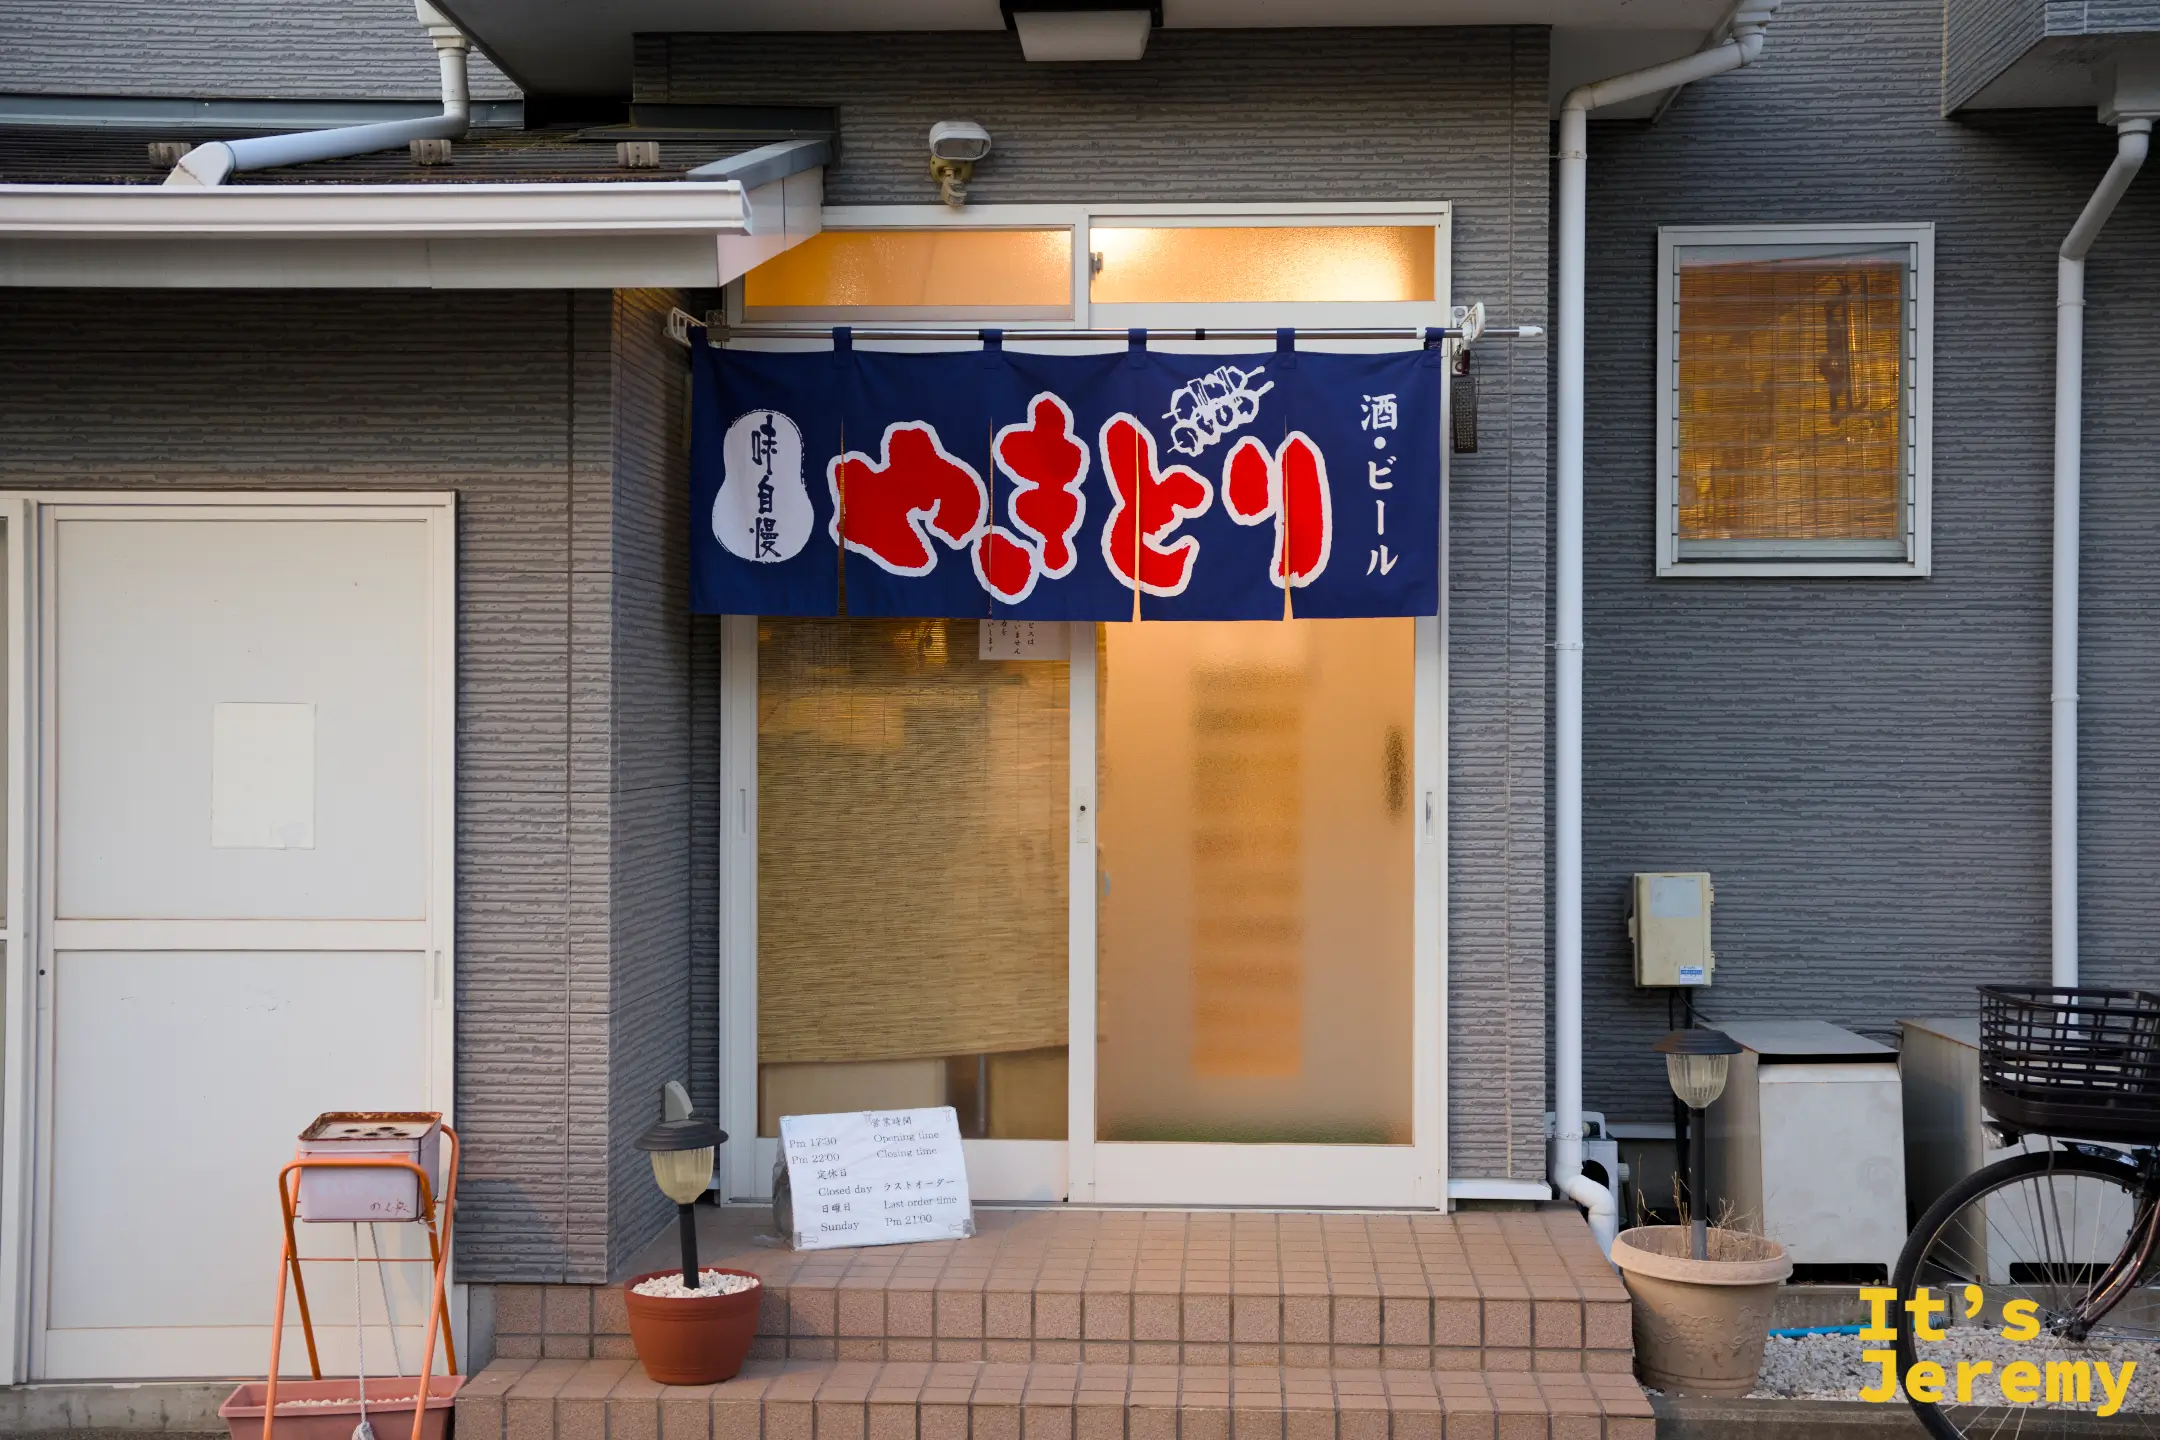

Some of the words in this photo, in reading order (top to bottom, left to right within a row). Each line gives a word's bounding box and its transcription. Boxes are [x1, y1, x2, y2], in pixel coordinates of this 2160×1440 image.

[750, 414, 781, 558] 味自慢
[826, 391, 1332, 605] やきとり
[873, 1132, 916, 1144] Opening
[919, 1130, 940, 1140] time
[789, 1139, 806, 1149] Pm
[876, 1148, 913, 1159] Closing
[916, 1147, 938, 1156] time
[792, 1155, 808, 1165] Pm
[817, 1168, 848, 1180] 定休日
[818, 1185, 851, 1197] Closed
[854, 1184, 873, 1195] day
[884, 1178, 955, 1193] ラストオーダー
[821, 1203, 851, 1214] 日曜日
[884, 1199, 905, 1210] Last
[907, 1197, 934, 1208] order
[936, 1195, 958, 1205] time
[820, 1220, 860, 1233] Sunday
[885, 1217, 902, 1228] Pm
